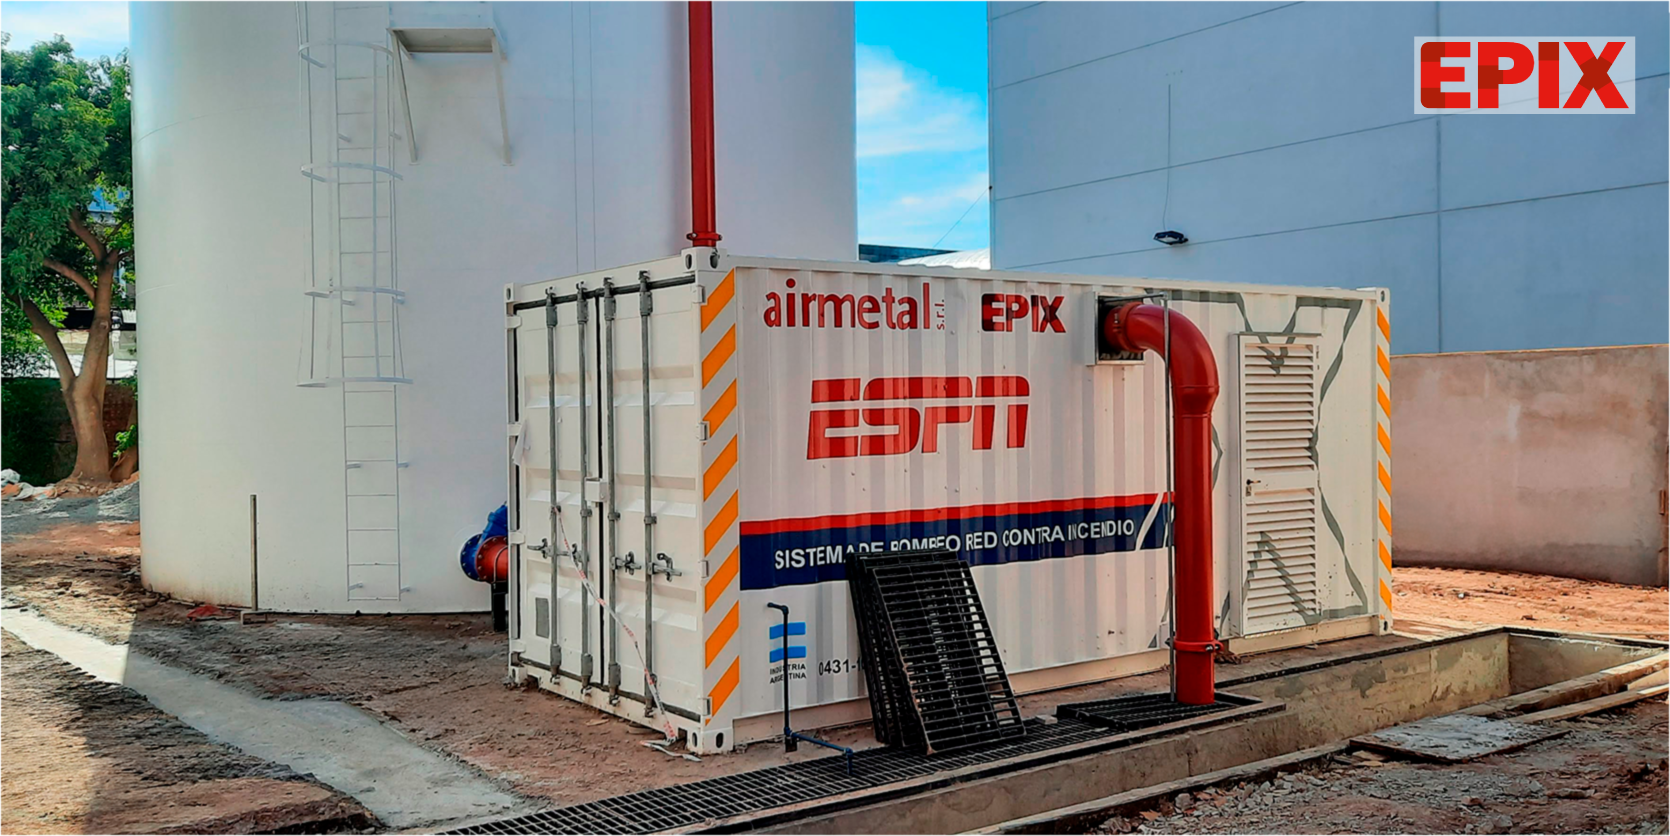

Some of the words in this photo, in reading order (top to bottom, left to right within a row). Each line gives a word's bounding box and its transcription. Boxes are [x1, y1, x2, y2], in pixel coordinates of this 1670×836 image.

[763, 278, 931, 330] airmetal
[934, 299, 945, 331] s.r.l.
[981, 293, 1067, 333] EPIX
[806, 375, 1030, 460] ESPN
[966, 532, 998, 551] RED
[1002, 525, 1065, 547] CONTRA
[1068, 519, 1134, 541] INCENDIO
[769, 663, 807, 675] INDUTRIA
[769, 672, 807, 684] ARGETINA
